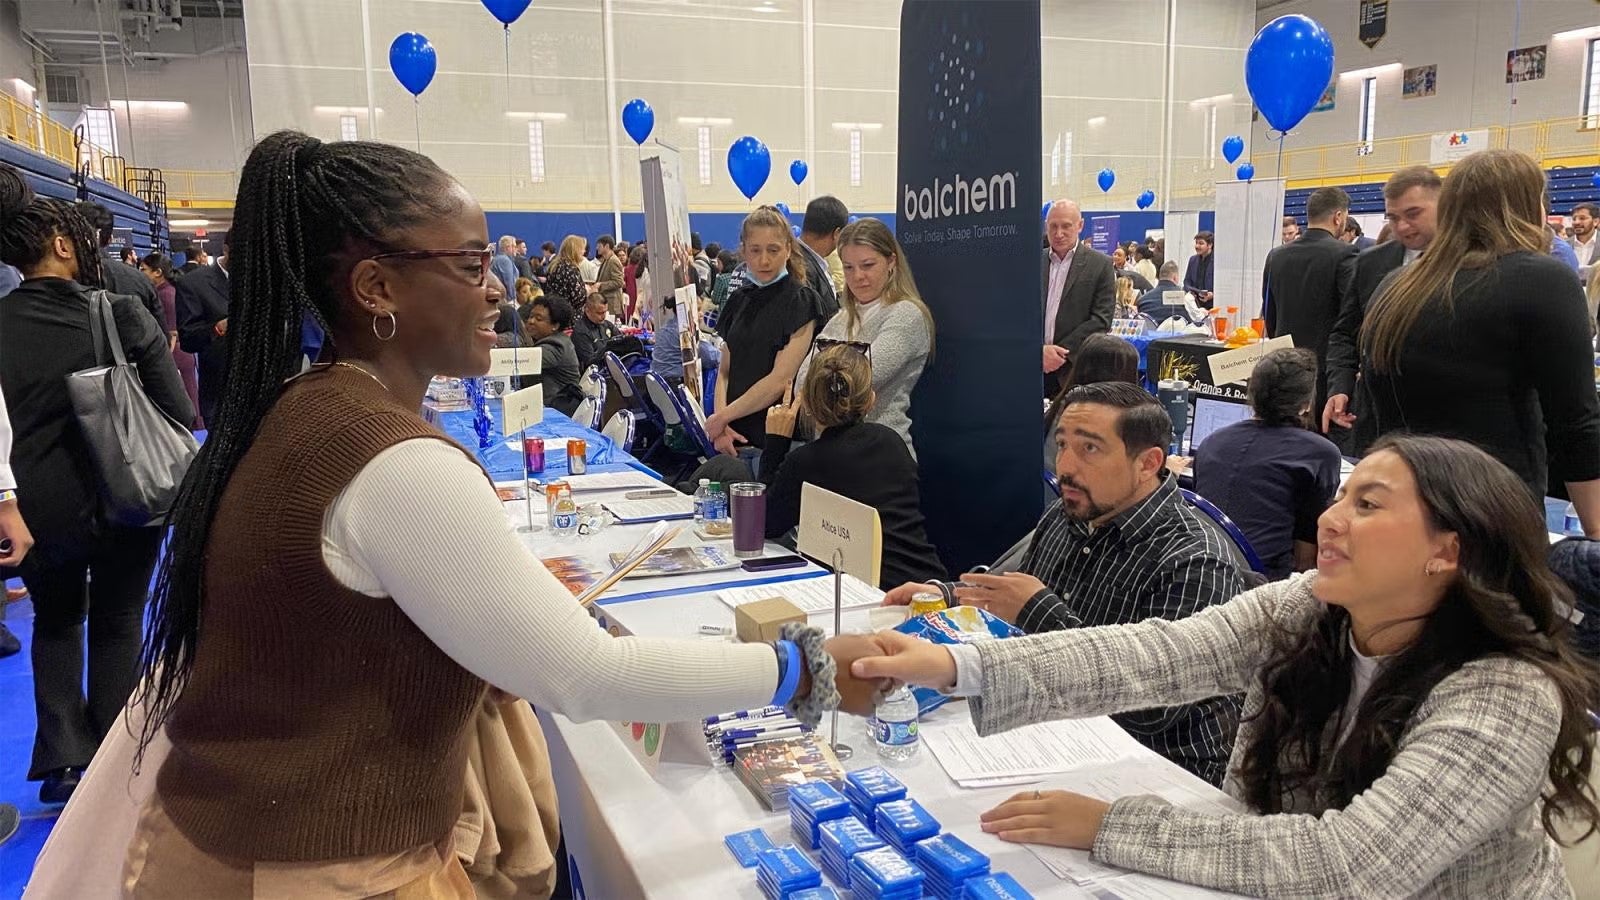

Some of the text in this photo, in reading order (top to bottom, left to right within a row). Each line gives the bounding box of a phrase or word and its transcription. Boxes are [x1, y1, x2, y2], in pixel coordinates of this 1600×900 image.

[904, 171, 1016, 221] balchem
[904, 231, 921, 243] Solve
[947, 228, 971, 241] Shape
[973, 224, 1018, 239] Tomorrow.
[1220, 359, 1247, 370] Balchem
[1194, 380, 1222, 396] Orange
[1224, 387, 1232, 397] &
[821, 518, 850, 541] Altice USA
